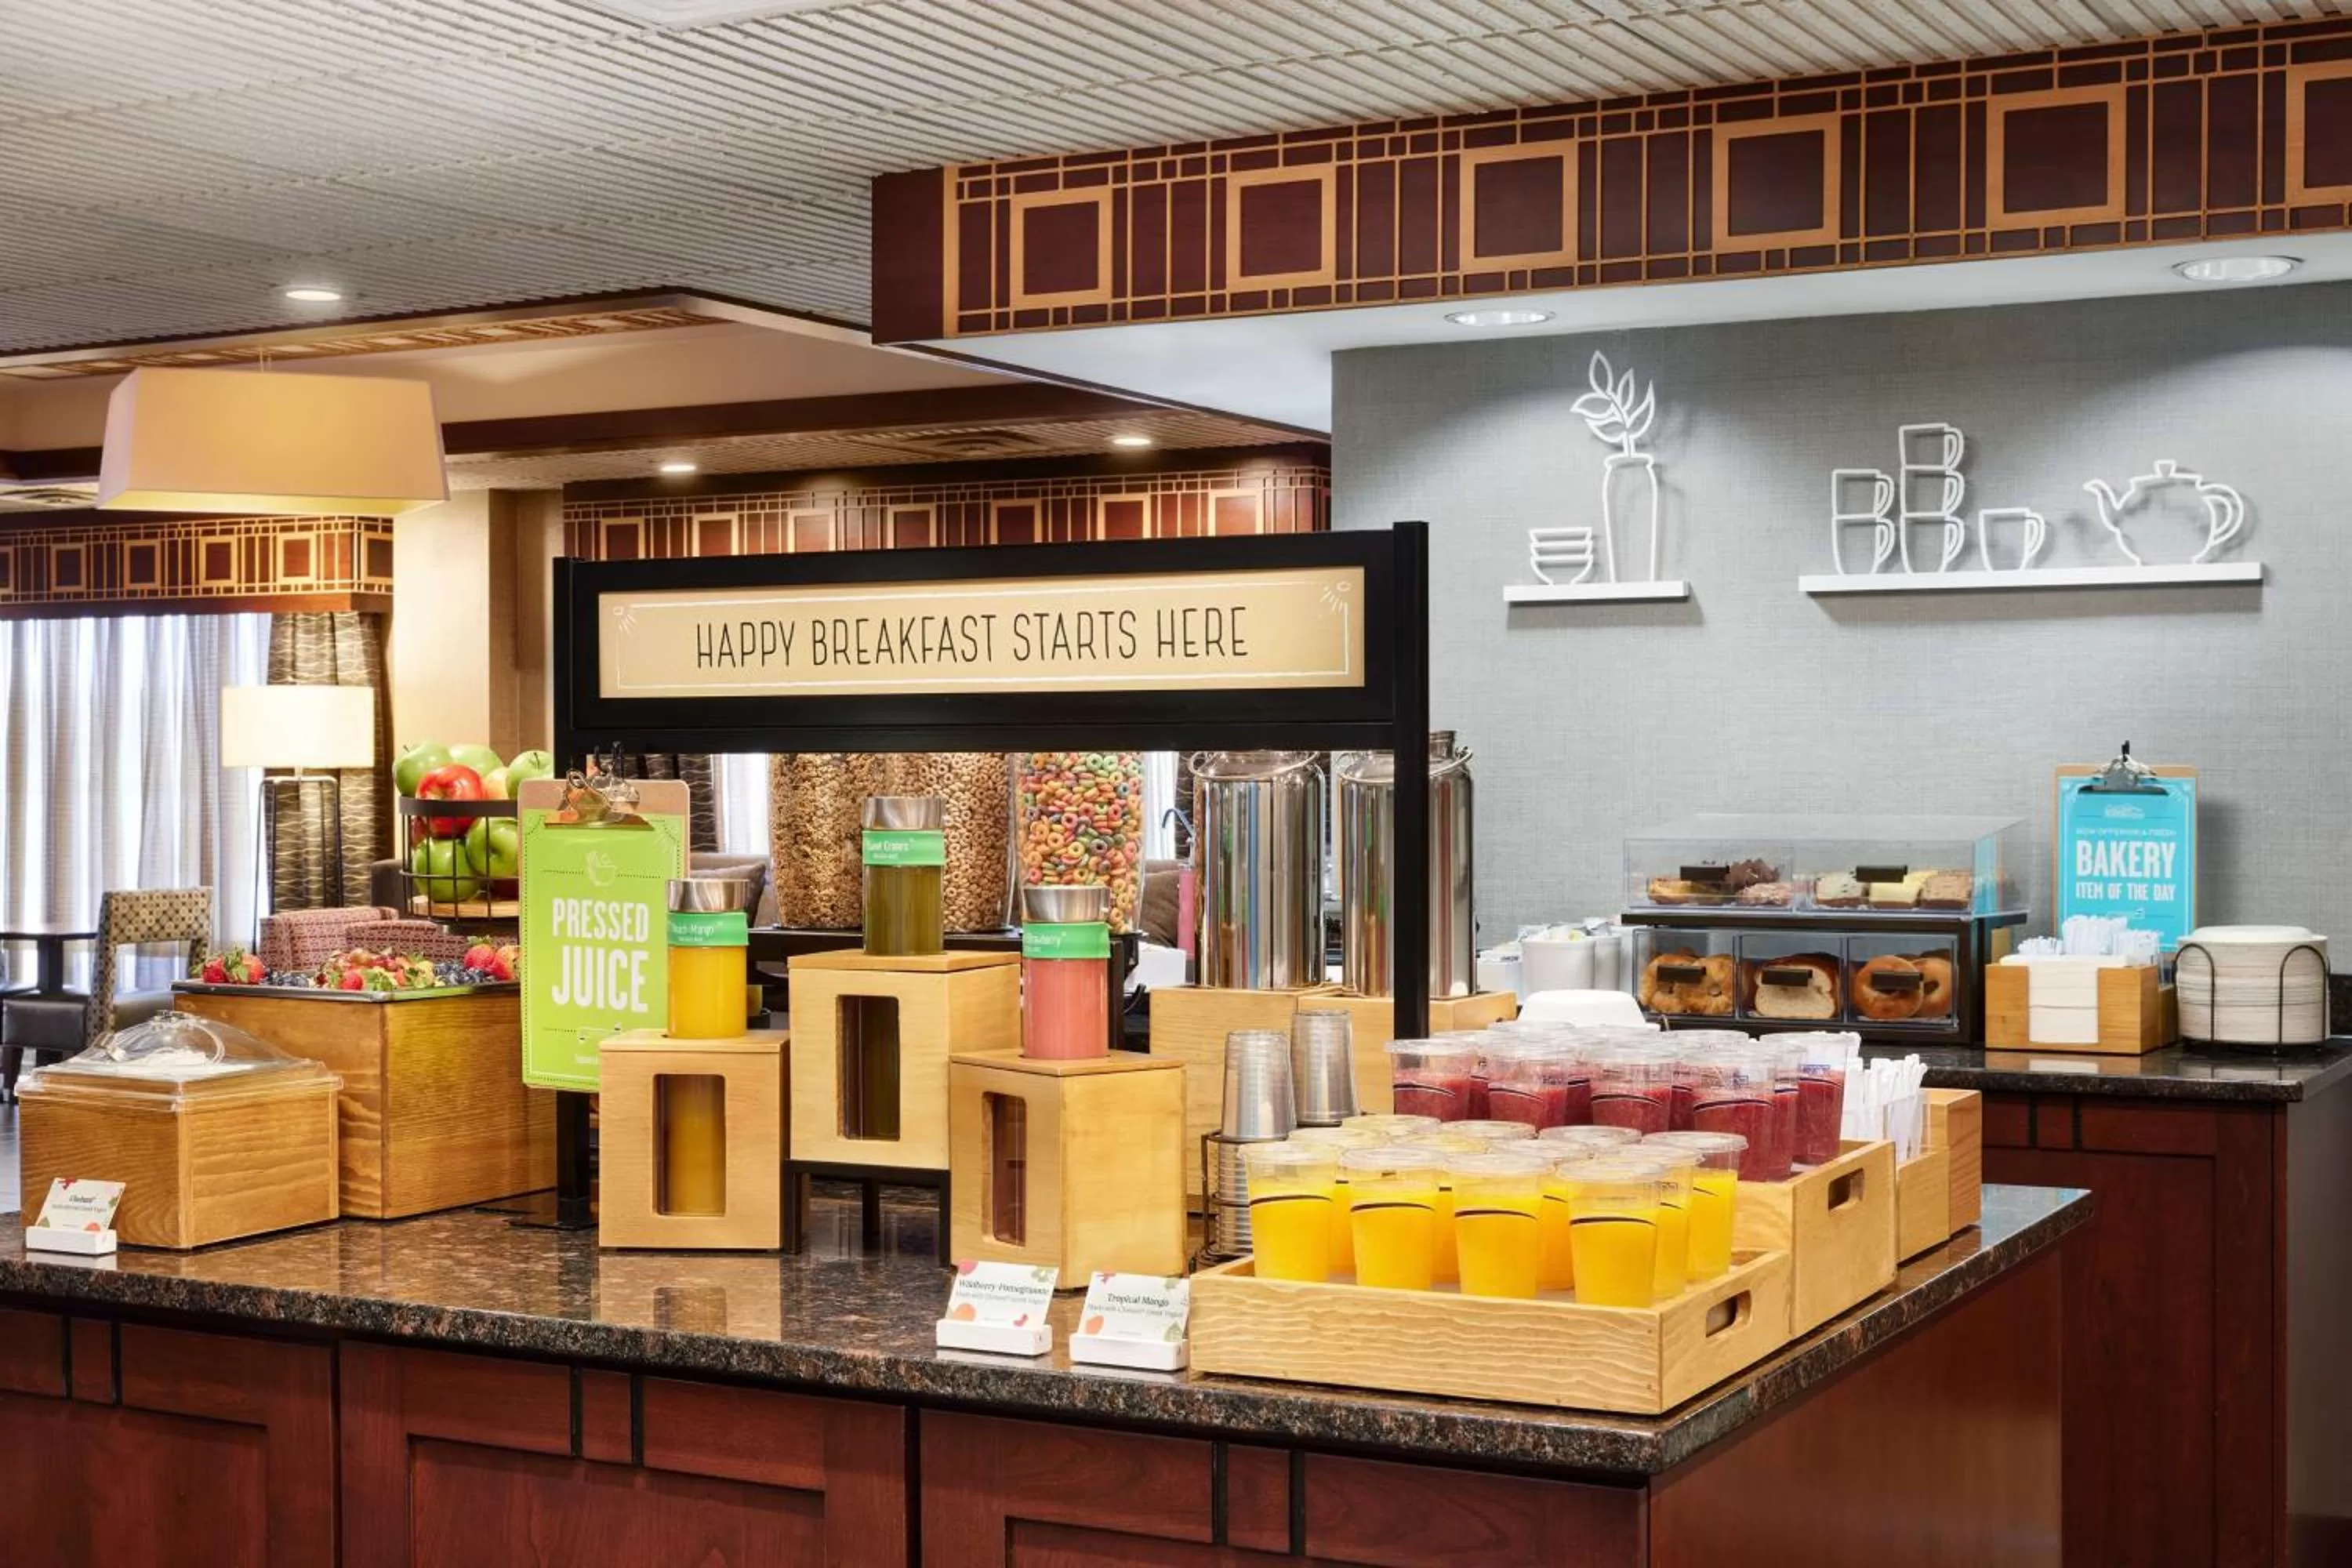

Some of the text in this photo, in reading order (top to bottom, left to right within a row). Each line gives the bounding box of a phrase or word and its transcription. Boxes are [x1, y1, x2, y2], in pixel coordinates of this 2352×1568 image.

[696, 606, 1249, 668] HAPPY BREAKFAST STARTS HERE
[2076, 840, 2177, 878] BAKERY
[2075, 881, 2176, 902] ITEM OF THE DAY
[552, 898, 649, 943] PRESSED
[551, 944, 650, 1014] JUICE
[959, 1279, 995, 1293] Wildberry
[1107, 1293, 1170, 1308] Tropical Mango
